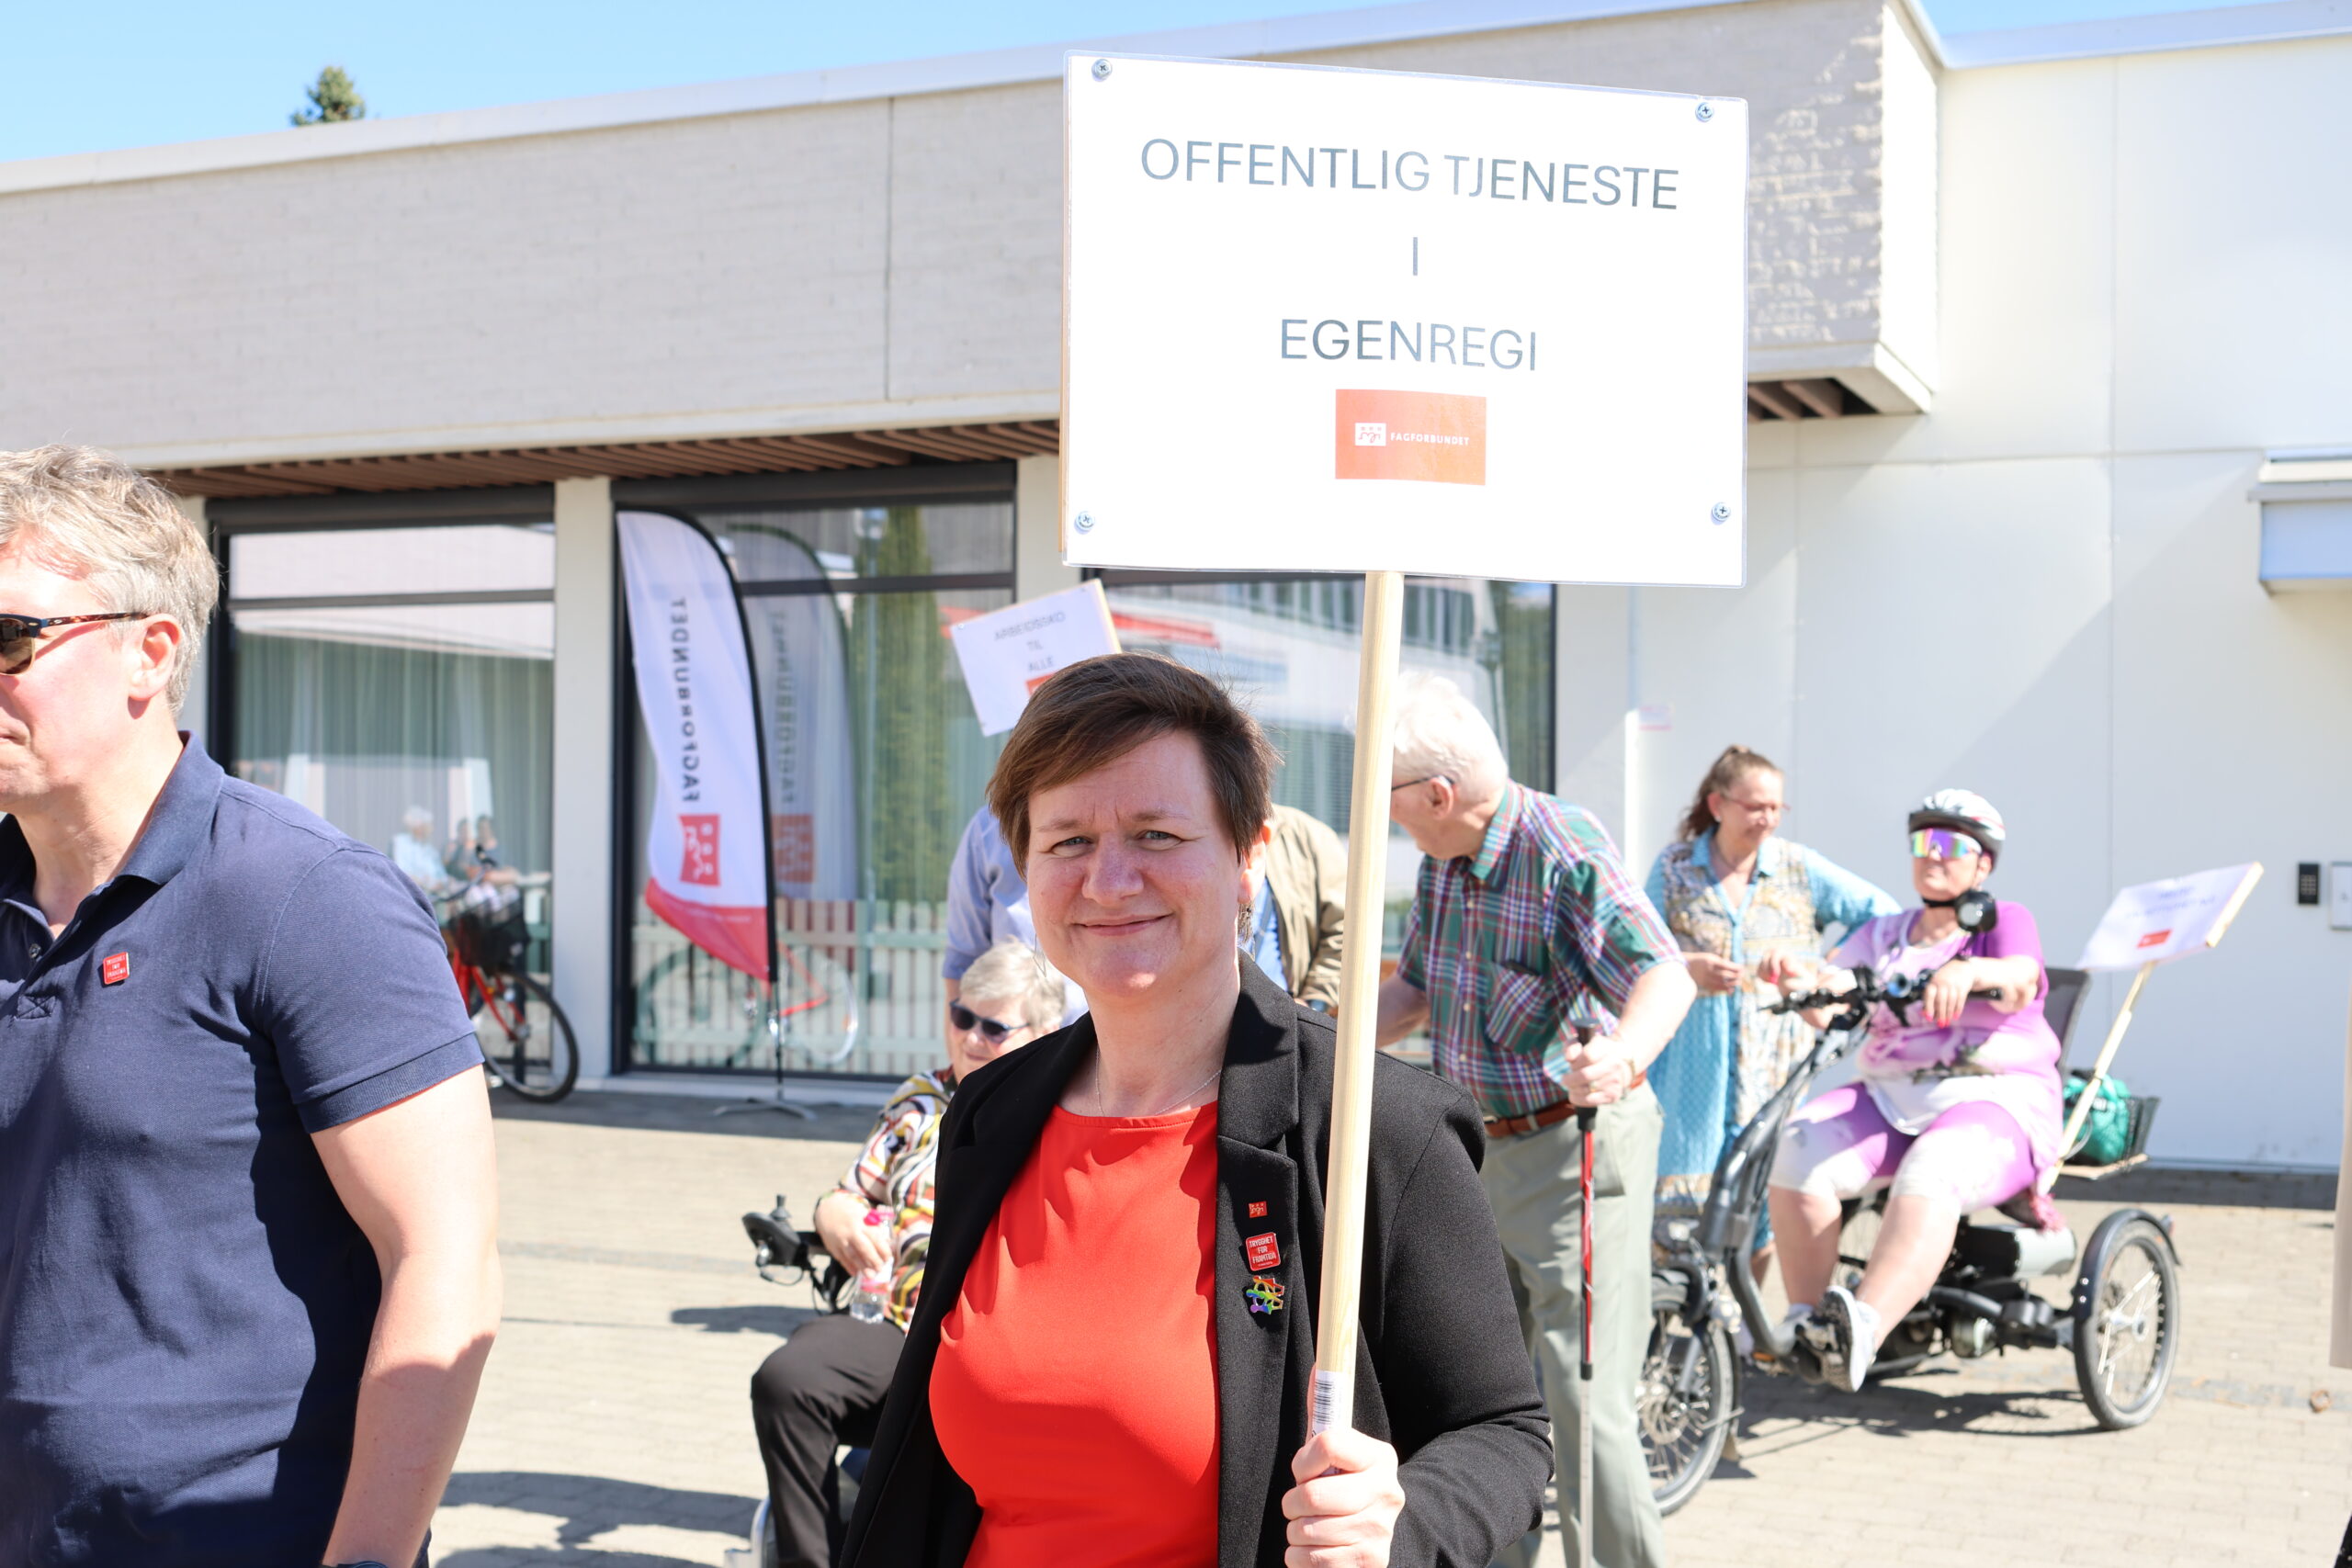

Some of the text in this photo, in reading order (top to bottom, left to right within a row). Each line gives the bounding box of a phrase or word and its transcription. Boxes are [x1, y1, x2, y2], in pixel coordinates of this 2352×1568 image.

[1141, 139, 1679, 210] OFFENTLIG TJENESTE
[1412, 236, 1419, 276] I
[1281, 318, 1536, 371] EGENREGI
[1390, 432, 1470, 446] FAGFORBUNDET
